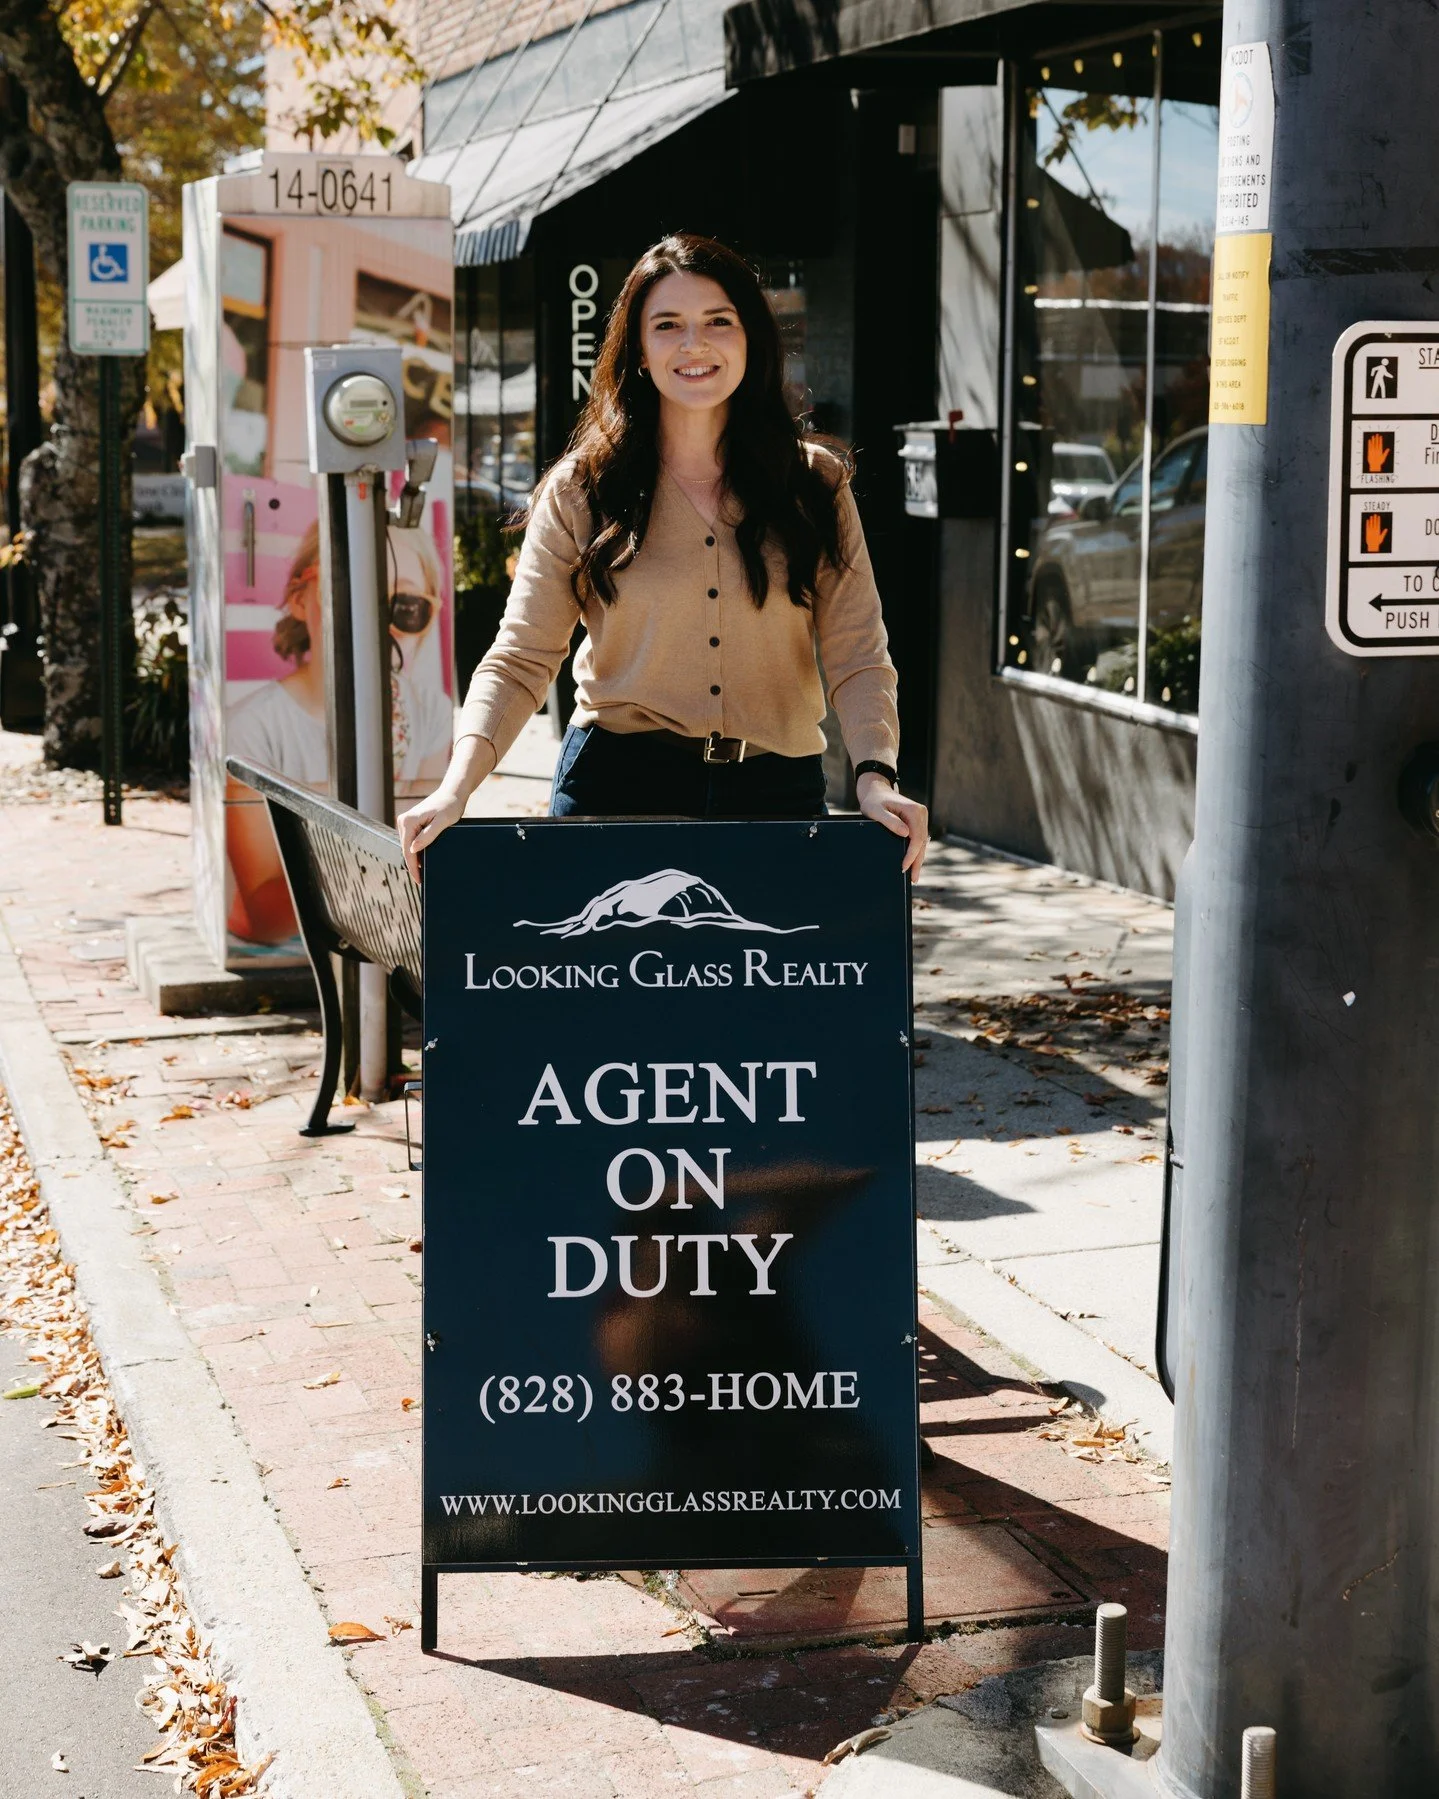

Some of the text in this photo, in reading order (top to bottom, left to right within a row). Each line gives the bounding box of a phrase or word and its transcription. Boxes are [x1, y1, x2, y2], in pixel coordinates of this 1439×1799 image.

[1231, 49, 1254, 65] NCDOT
[1246, 154, 1261, 166] AND
[269, 168, 392, 212] 14-0641
[75, 193, 140, 212] RESERVED
[80, 216, 137, 234] PARKING
[569, 264, 599, 401] OPEN
[1361, 474, 1395, 484] FLASHING
[1364, 501, 1391, 511] STEADY
[1404, 575, 1423, 592] TO
[1385, 611, 1430, 629] PUSH
[464, 949, 869, 990] LOOKING GLASS REALTY
[517, 1061, 818, 1126] AGENT
[606, 1147, 732, 1212] ON
[546, 1233, 794, 1298] DUTY
[479, 1371, 861, 1425] (828) 883-HOME
[440, 1488, 902, 1517] WWW.LOOKINGGLASSREALTY.COM
